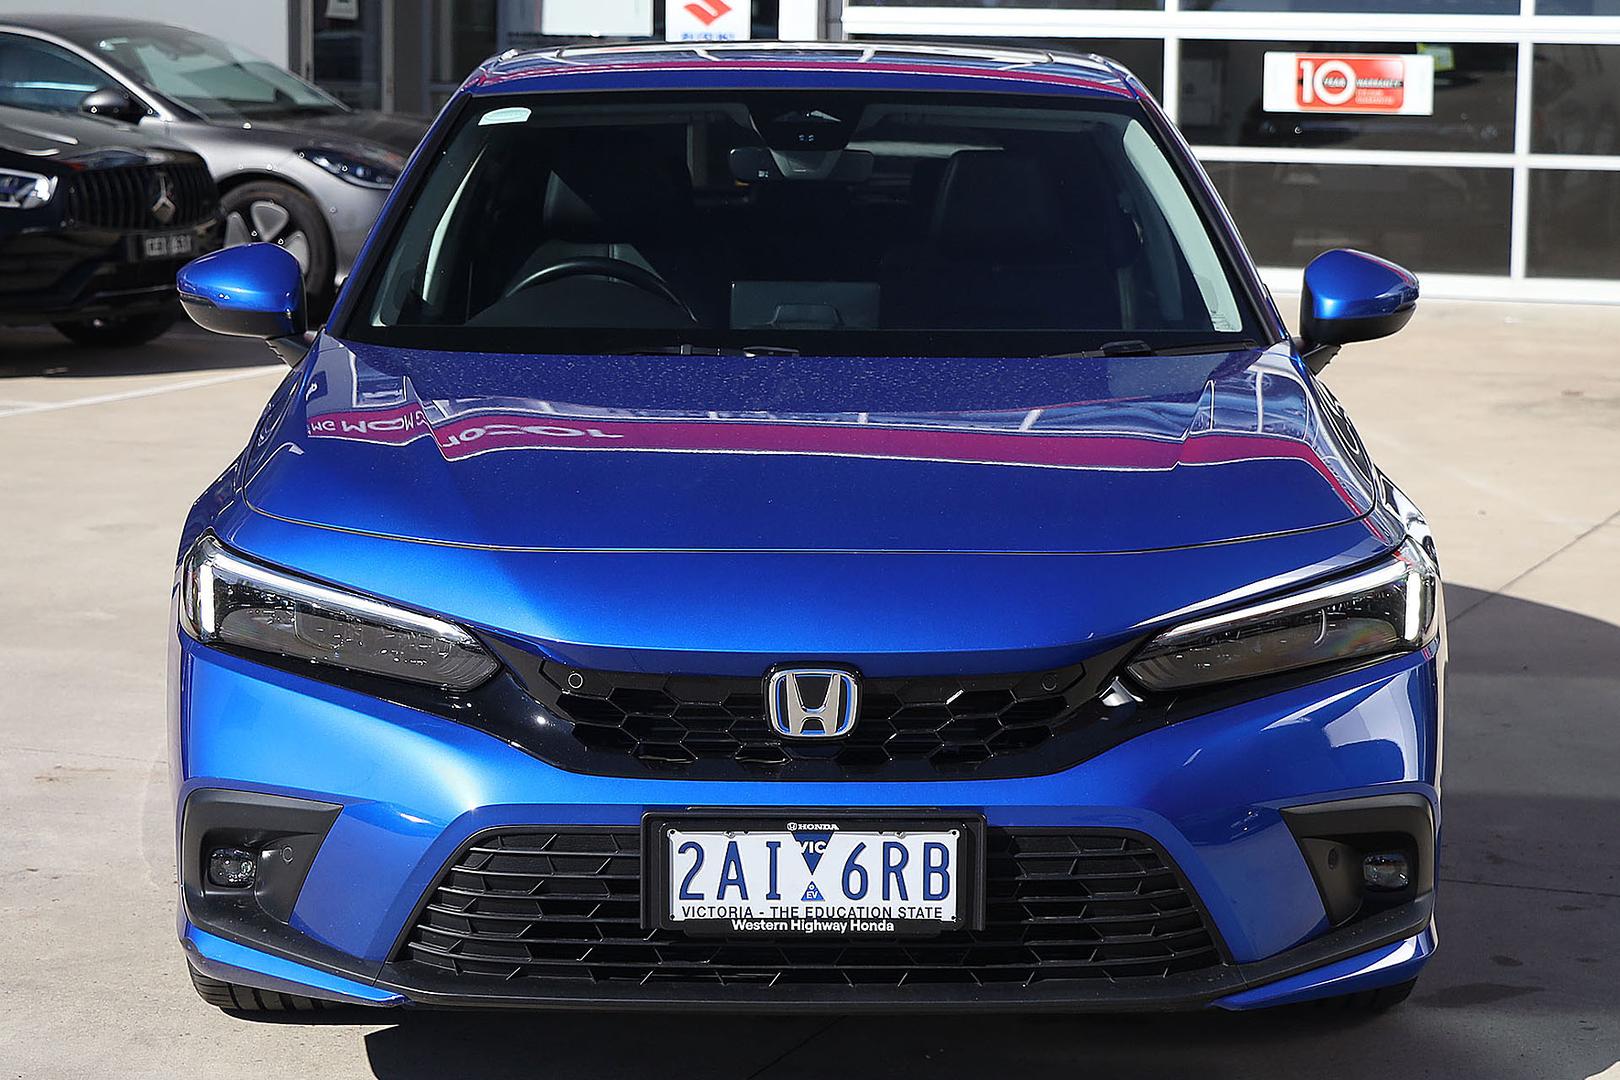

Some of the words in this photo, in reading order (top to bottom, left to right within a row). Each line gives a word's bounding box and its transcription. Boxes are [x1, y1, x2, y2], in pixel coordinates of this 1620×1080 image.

[1300, 60, 1357, 104] 10
[798, 823, 840, 831] HONDA
[797, 840, 827, 855] VIC
[678, 841, 781, 900] 2AI
[841, 841, 950, 901] 6RB
[807, 890, 818, 898] EV
[682, 906, 752, 919] VICTORIA
[770, 906, 799, 919] THE
[805, 906, 892, 919] EDUCATION
[898, 906, 943, 919] STATE
[732, 919, 788, 932] Western
[791, 919, 847, 934] Highway
[850, 919, 895, 932] Honda
